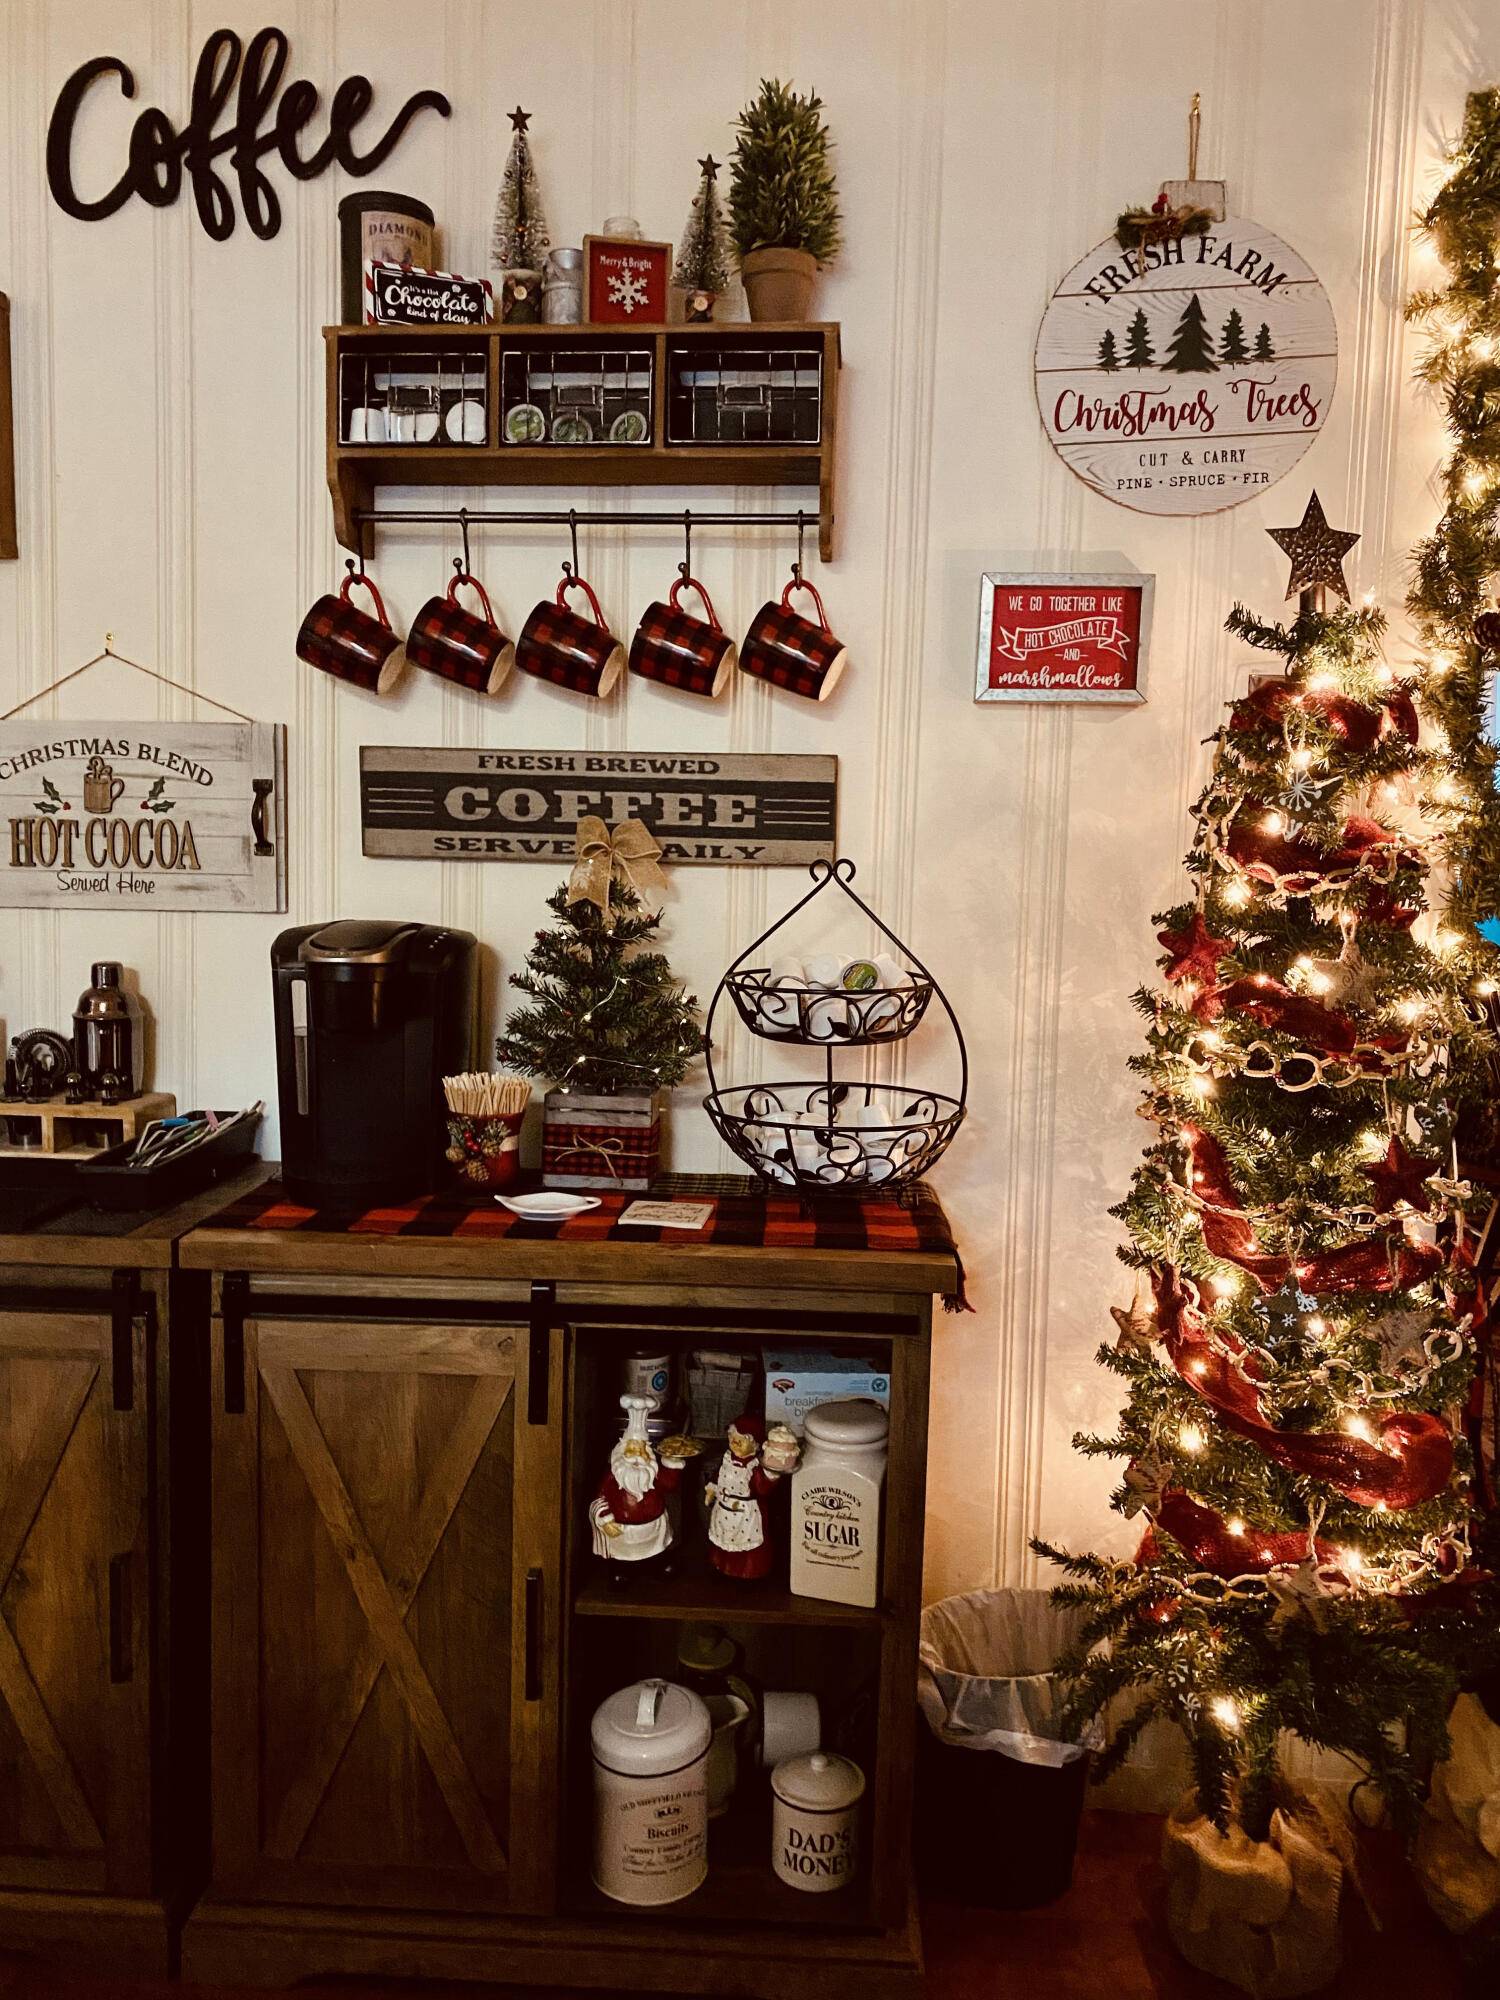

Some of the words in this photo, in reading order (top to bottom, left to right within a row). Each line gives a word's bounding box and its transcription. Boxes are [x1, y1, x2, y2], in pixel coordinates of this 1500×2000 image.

[47, 27, 451, 241] Coffee
[600, 255, 621, 268] Merry
[629, 257, 652, 272] Bright
[1084, 236, 1185, 304] FRESH
[1195, 236, 1288, 296] FARM
[384, 284, 478, 312] Chocolate
[406, 306, 427, 318] kind
[430, 310, 440, 322] of
[443, 308, 470, 325] day
[1054, 385, 1218, 437] Christmas
[1225, 375, 1322, 427] Trees
[1139, 453, 1169, 467] CUT
[1182, 450, 1194, 466] &
[1203, 449, 1246, 464] CARRY
[1117, 477, 1152, 490] PINE
[1169, 473, 1226, 488] SPRUCE
[1243, 472, 1270, 484] FIR
[1008, 596, 1023, 611] WE
[1029, 596, 1042, 611] GO
[1049, 596, 1096, 612] TOGETHER
[1102, 597, 1123, 612] LIKE
[1024, 632, 1045, 648] HOT
[1048, 621, 1108, 645] CHOCOLATE
[1063, 648, 1080, 661] AND
[999, 665, 1124, 688] marshmallows
[0, 738, 130, 780] CHRISTMAS
[137, 743, 214, 786] BLEND
[478, 754, 576, 772] FRESH
[585, 757, 720, 775] BREWED
[443, 785, 757, 829] COFFEE
[8, 816, 80, 868] HOT
[84, 817, 201, 870] COCOA
[434, 836, 577, 857] SERVE
[661, 842, 766, 860] AILY
[57, 869, 110, 893] Served
[116, 871, 156, 894] Here
[804, 1520, 860, 1547] SUGAR
[647, 1823, 689, 1839] Biscuits
[789, 1826, 850, 1854] DAD'S
